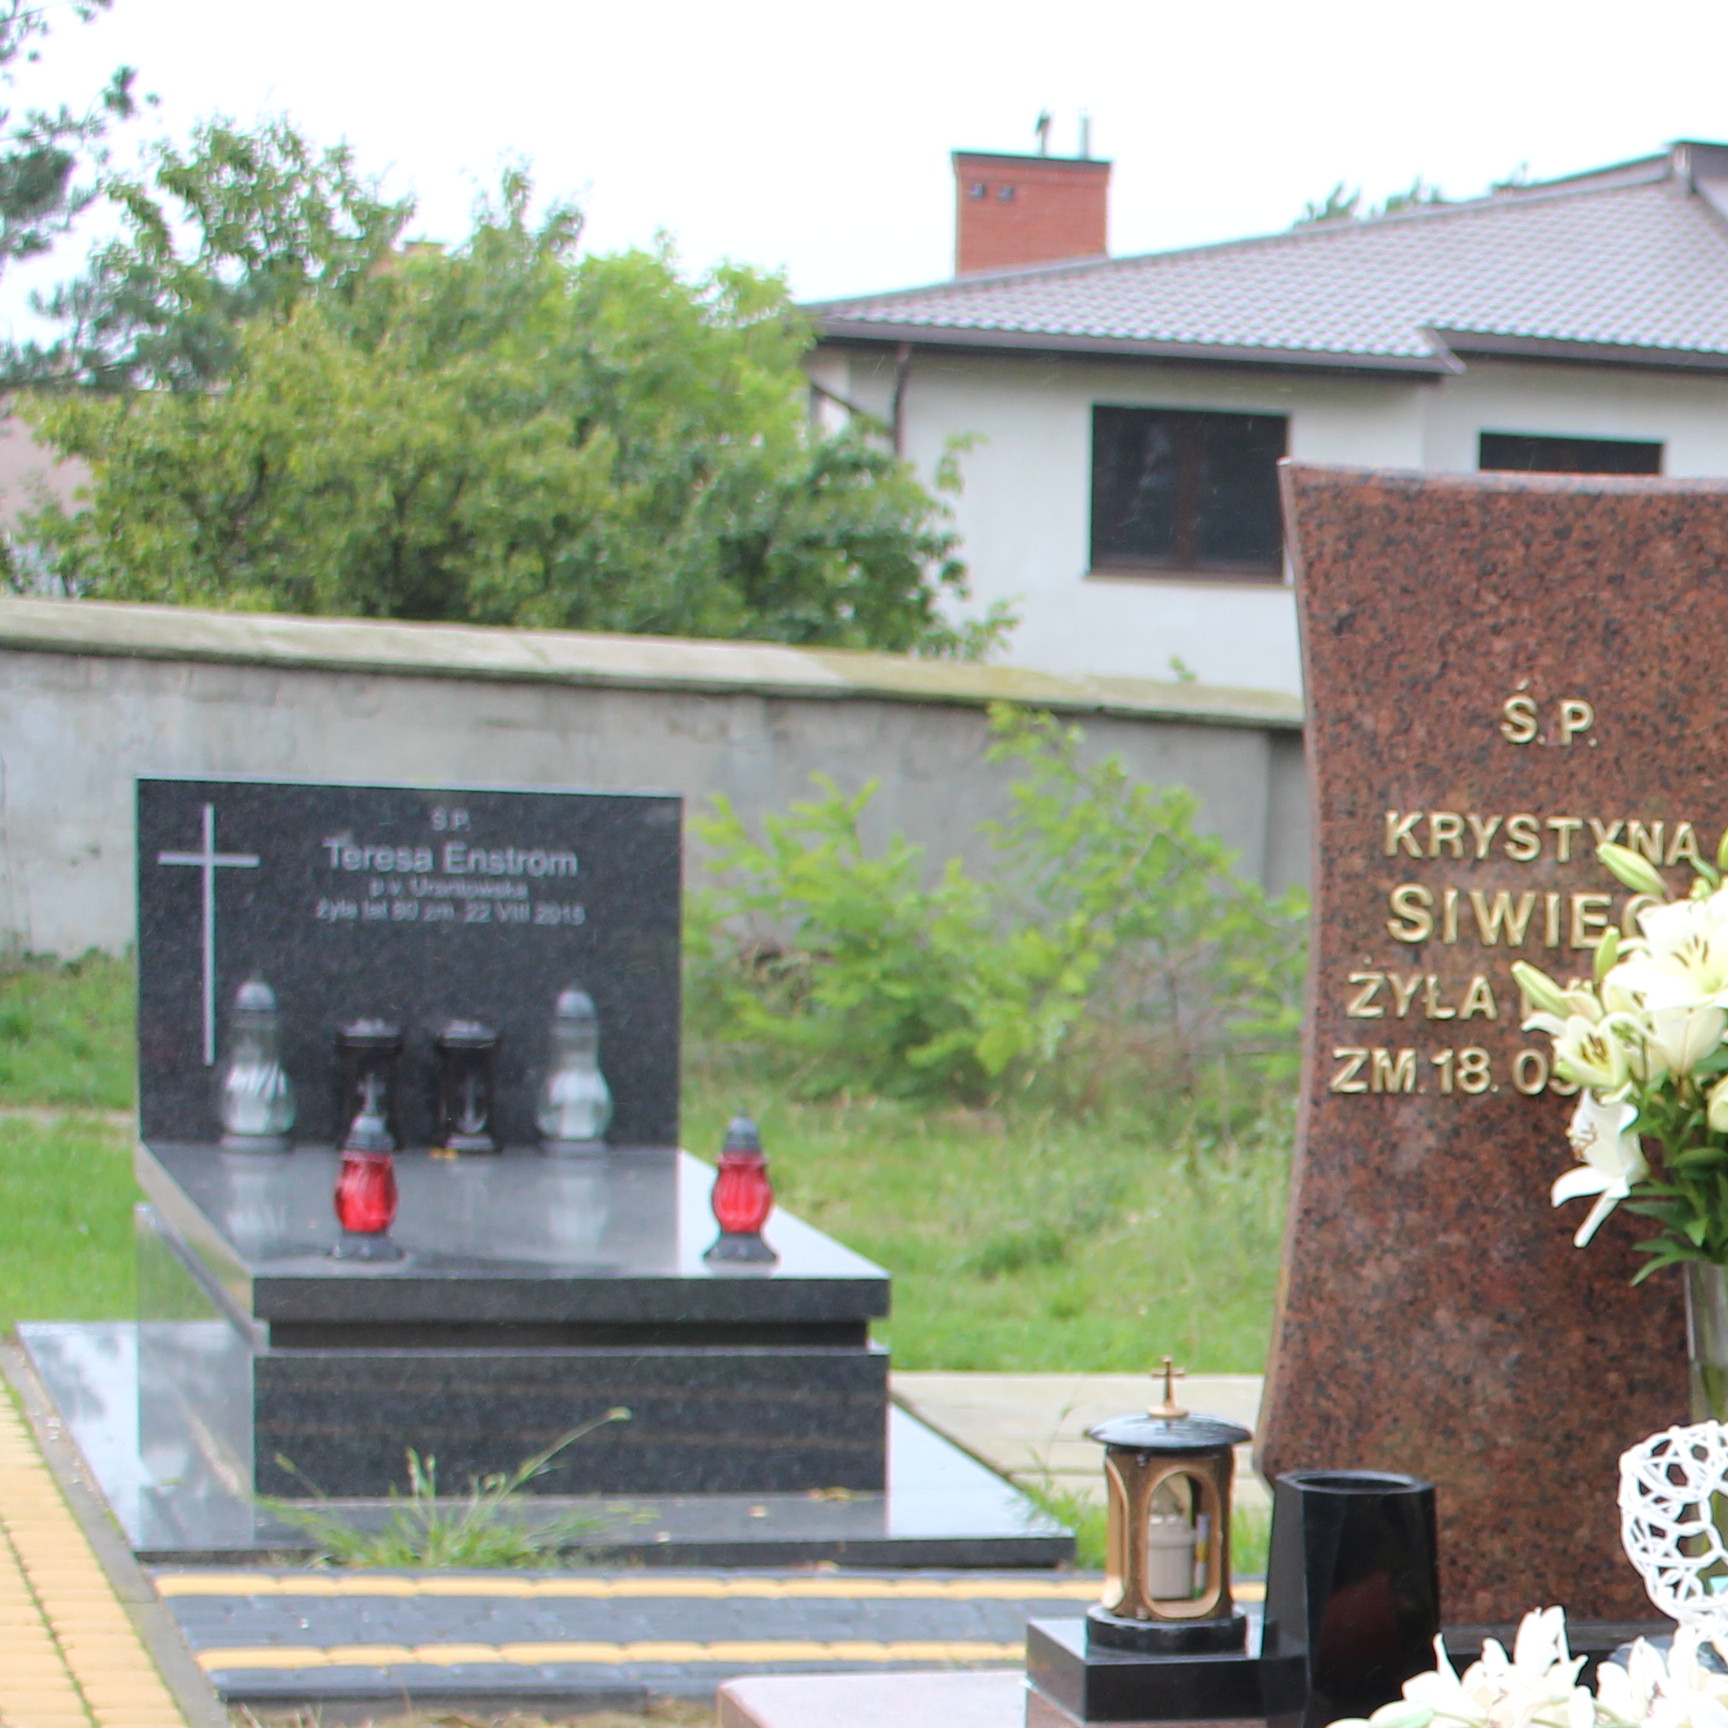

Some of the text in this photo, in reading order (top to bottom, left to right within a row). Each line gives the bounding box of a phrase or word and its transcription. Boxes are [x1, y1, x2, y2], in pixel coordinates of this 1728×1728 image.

[322, 835, 434, 873] Teresa
[1385, 809, 1701, 867] KRYSTYNA
[1346, 954, 1498, 1020] ŻYŁA
